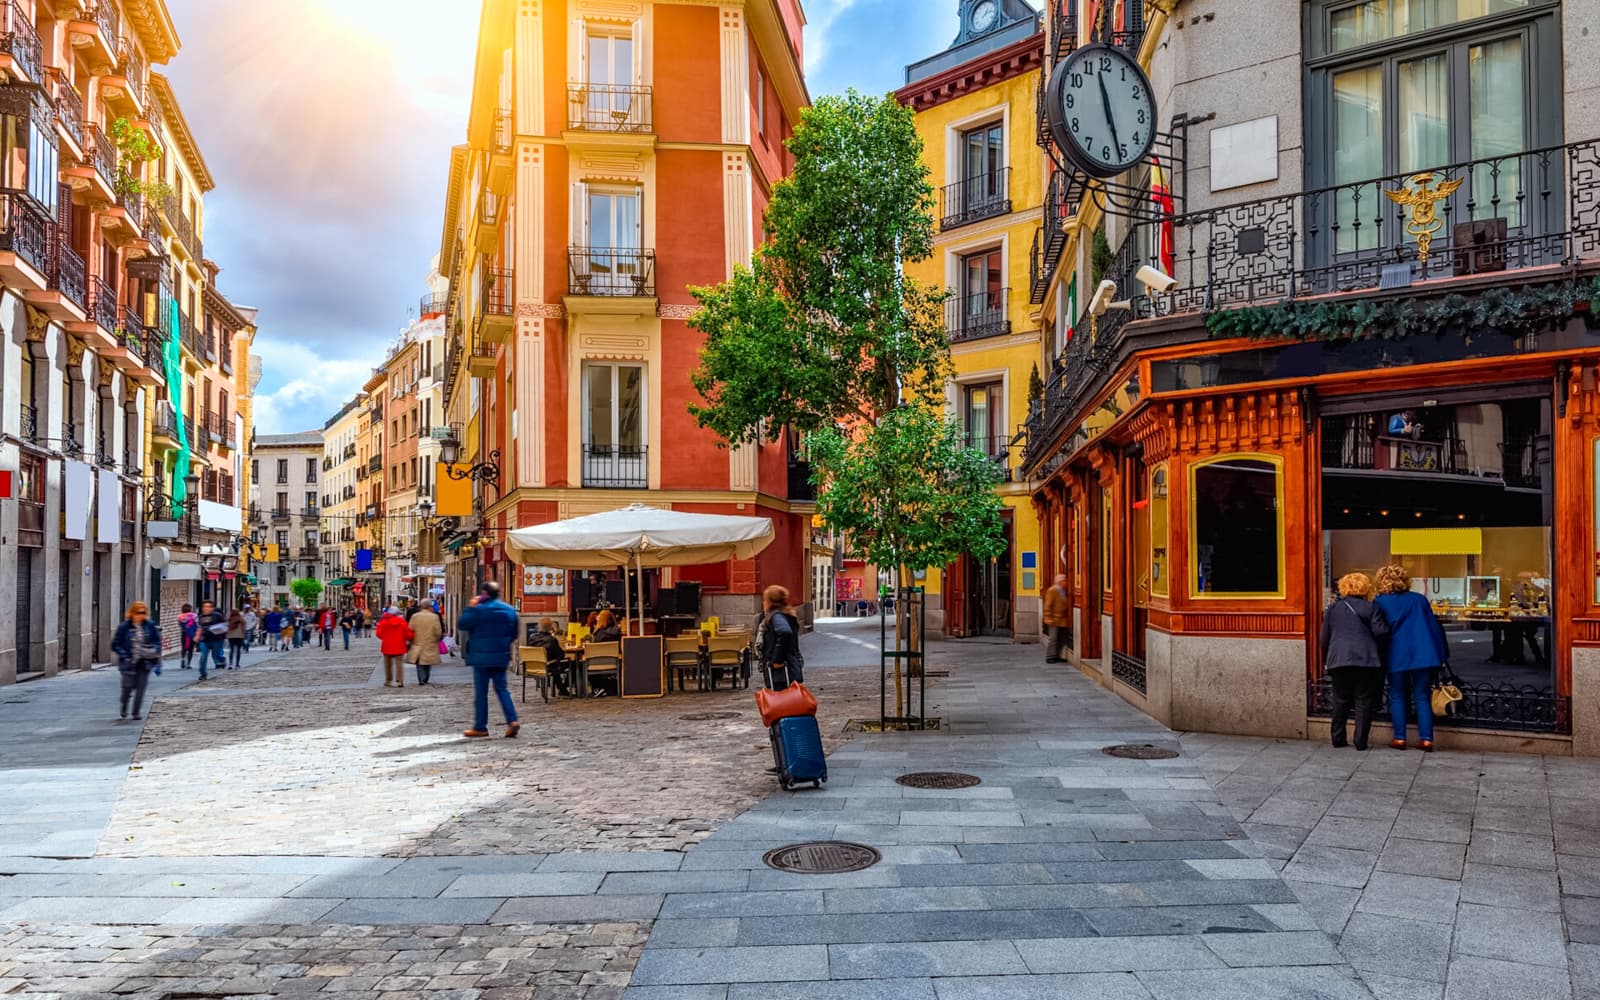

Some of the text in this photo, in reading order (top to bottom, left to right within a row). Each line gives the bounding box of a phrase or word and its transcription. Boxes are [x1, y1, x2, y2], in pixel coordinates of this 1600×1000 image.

[1084, 61, 1093, 75] 11
[1099, 57, 1112, 72] 12
[1071, 73, 1083, 88] 10
[1121, 68, 1126, 81] 1
[1132, 86, 1140, 100] 2
[1066, 94, 1074, 109] 9
[1138, 110, 1145, 124] 3
[1072, 118, 1079, 133] 8
[1085, 137, 1093, 151] 7
[1132, 131, 1140, 145] 4
[1103, 146, 1110, 160] 6
[1121, 144, 1127, 158] 5
